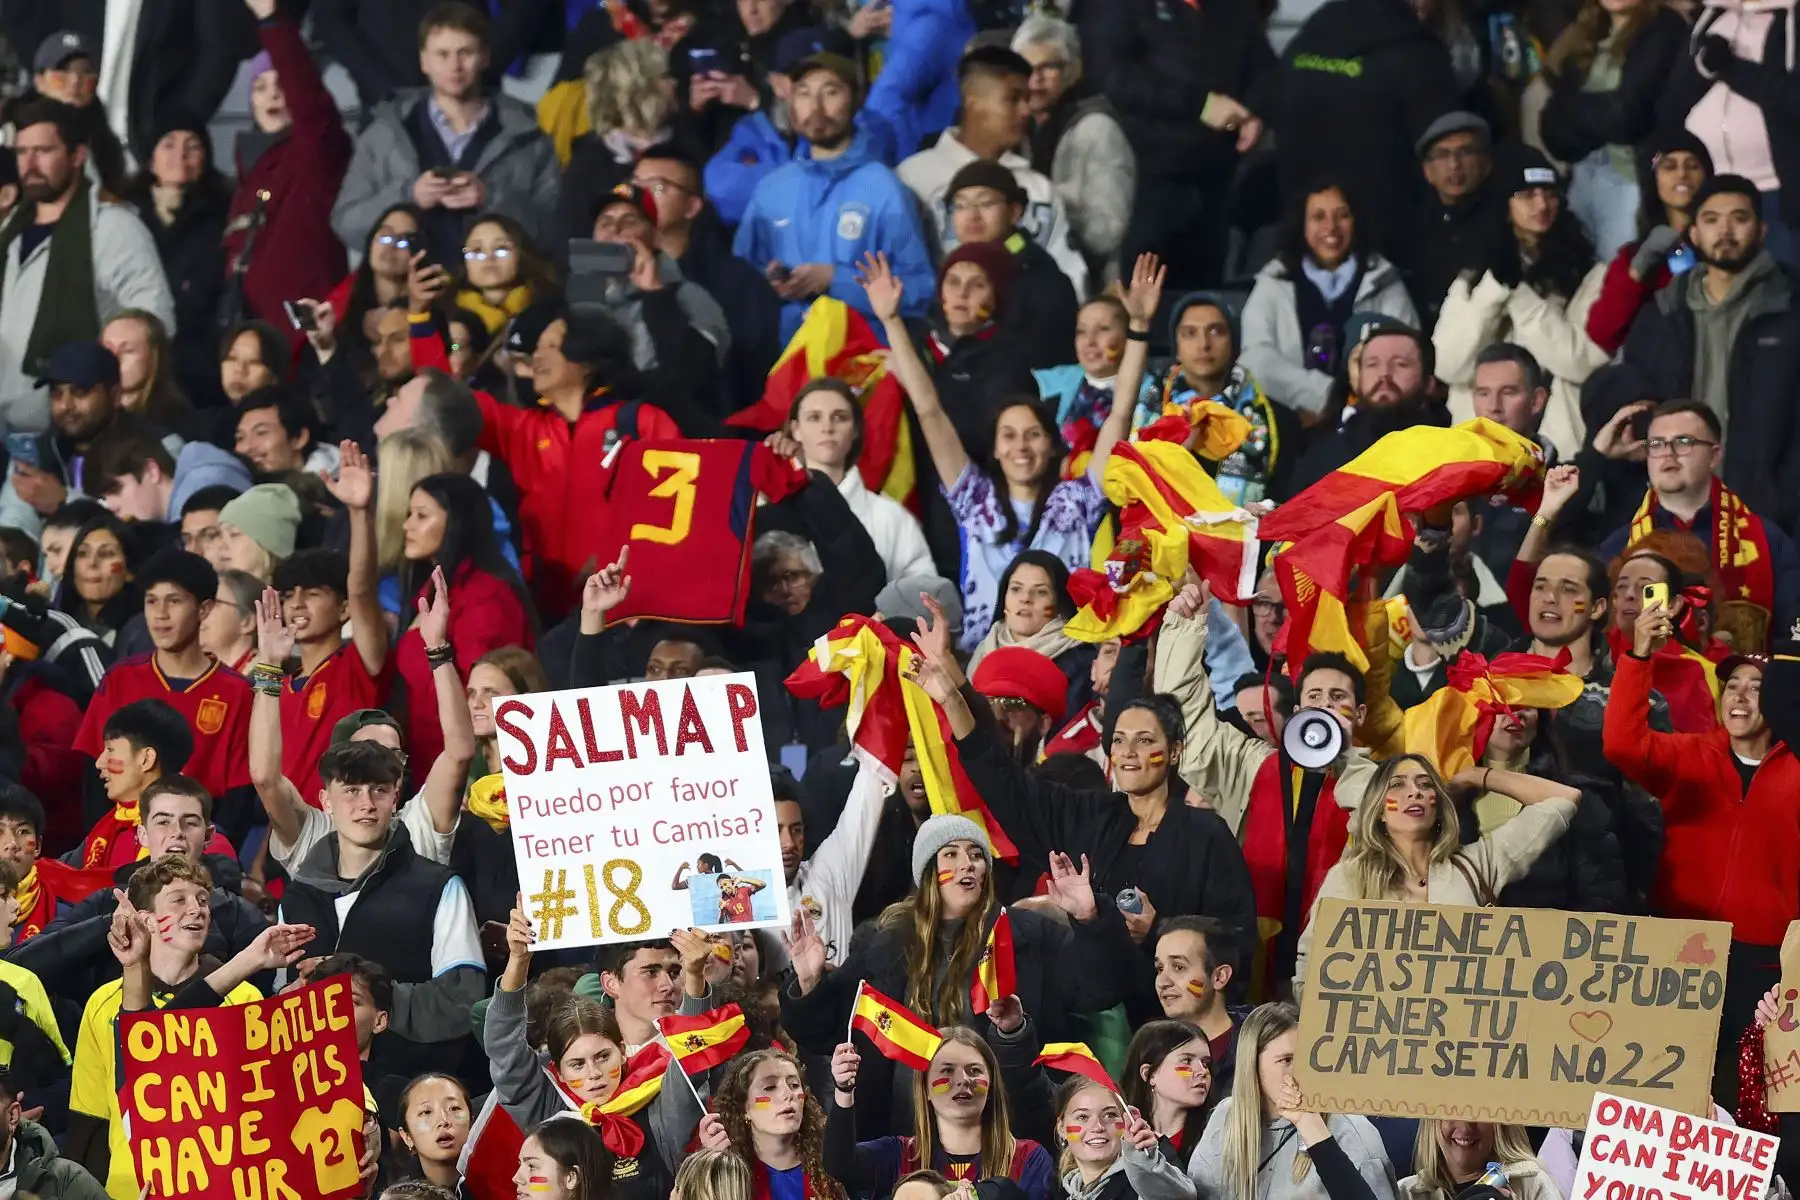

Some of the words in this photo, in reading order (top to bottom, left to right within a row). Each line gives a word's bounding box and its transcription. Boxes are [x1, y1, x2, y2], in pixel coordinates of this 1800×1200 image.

[631, 449, 700, 545] 3
[495, 682, 715, 776] SALMA
[725, 683, 757, 753] P
[517, 788, 601, 819] Puedo
[608, 781, 653, 810] por
[670, 777, 739, 802] favor
[519, 834, 594, 858] Tener
[611, 825, 639, 848] tu
[653, 808, 763, 845] Camisa?
[529, 858, 652, 942] #18
[733, 902, 745, 914] 18
[1326, 907, 1531, 957] ATHENEA
[1563, 917, 1649, 964] DEL
[127, 1013, 217, 1062] ONA
[244, 983, 349, 1054] BATLLE
[1318, 992, 1448, 1037] TENER
[1463, 998, 1518, 1041] TU
[133, 1071, 227, 1123] CAN
[241, 1059, 275, 1102] I
[292, 1044, 347, 1102] PLS
[1309, 1035, 1529, 1079] CAMISETA
[140, 1110, 271, 1197] HAVE
[319, 1128, 345, 1166] 2
[1596, 1098, 1664, 1137] ONA
[1669, 1115, 1774, 1171] BATLLE
[231, 1158, 302, 1200] UR
[1590, 1134, 1657, 1168] CAN
[1661, 1152, 1685, 1181] I
[1688, 1161, 1764, 1200] HAVE
